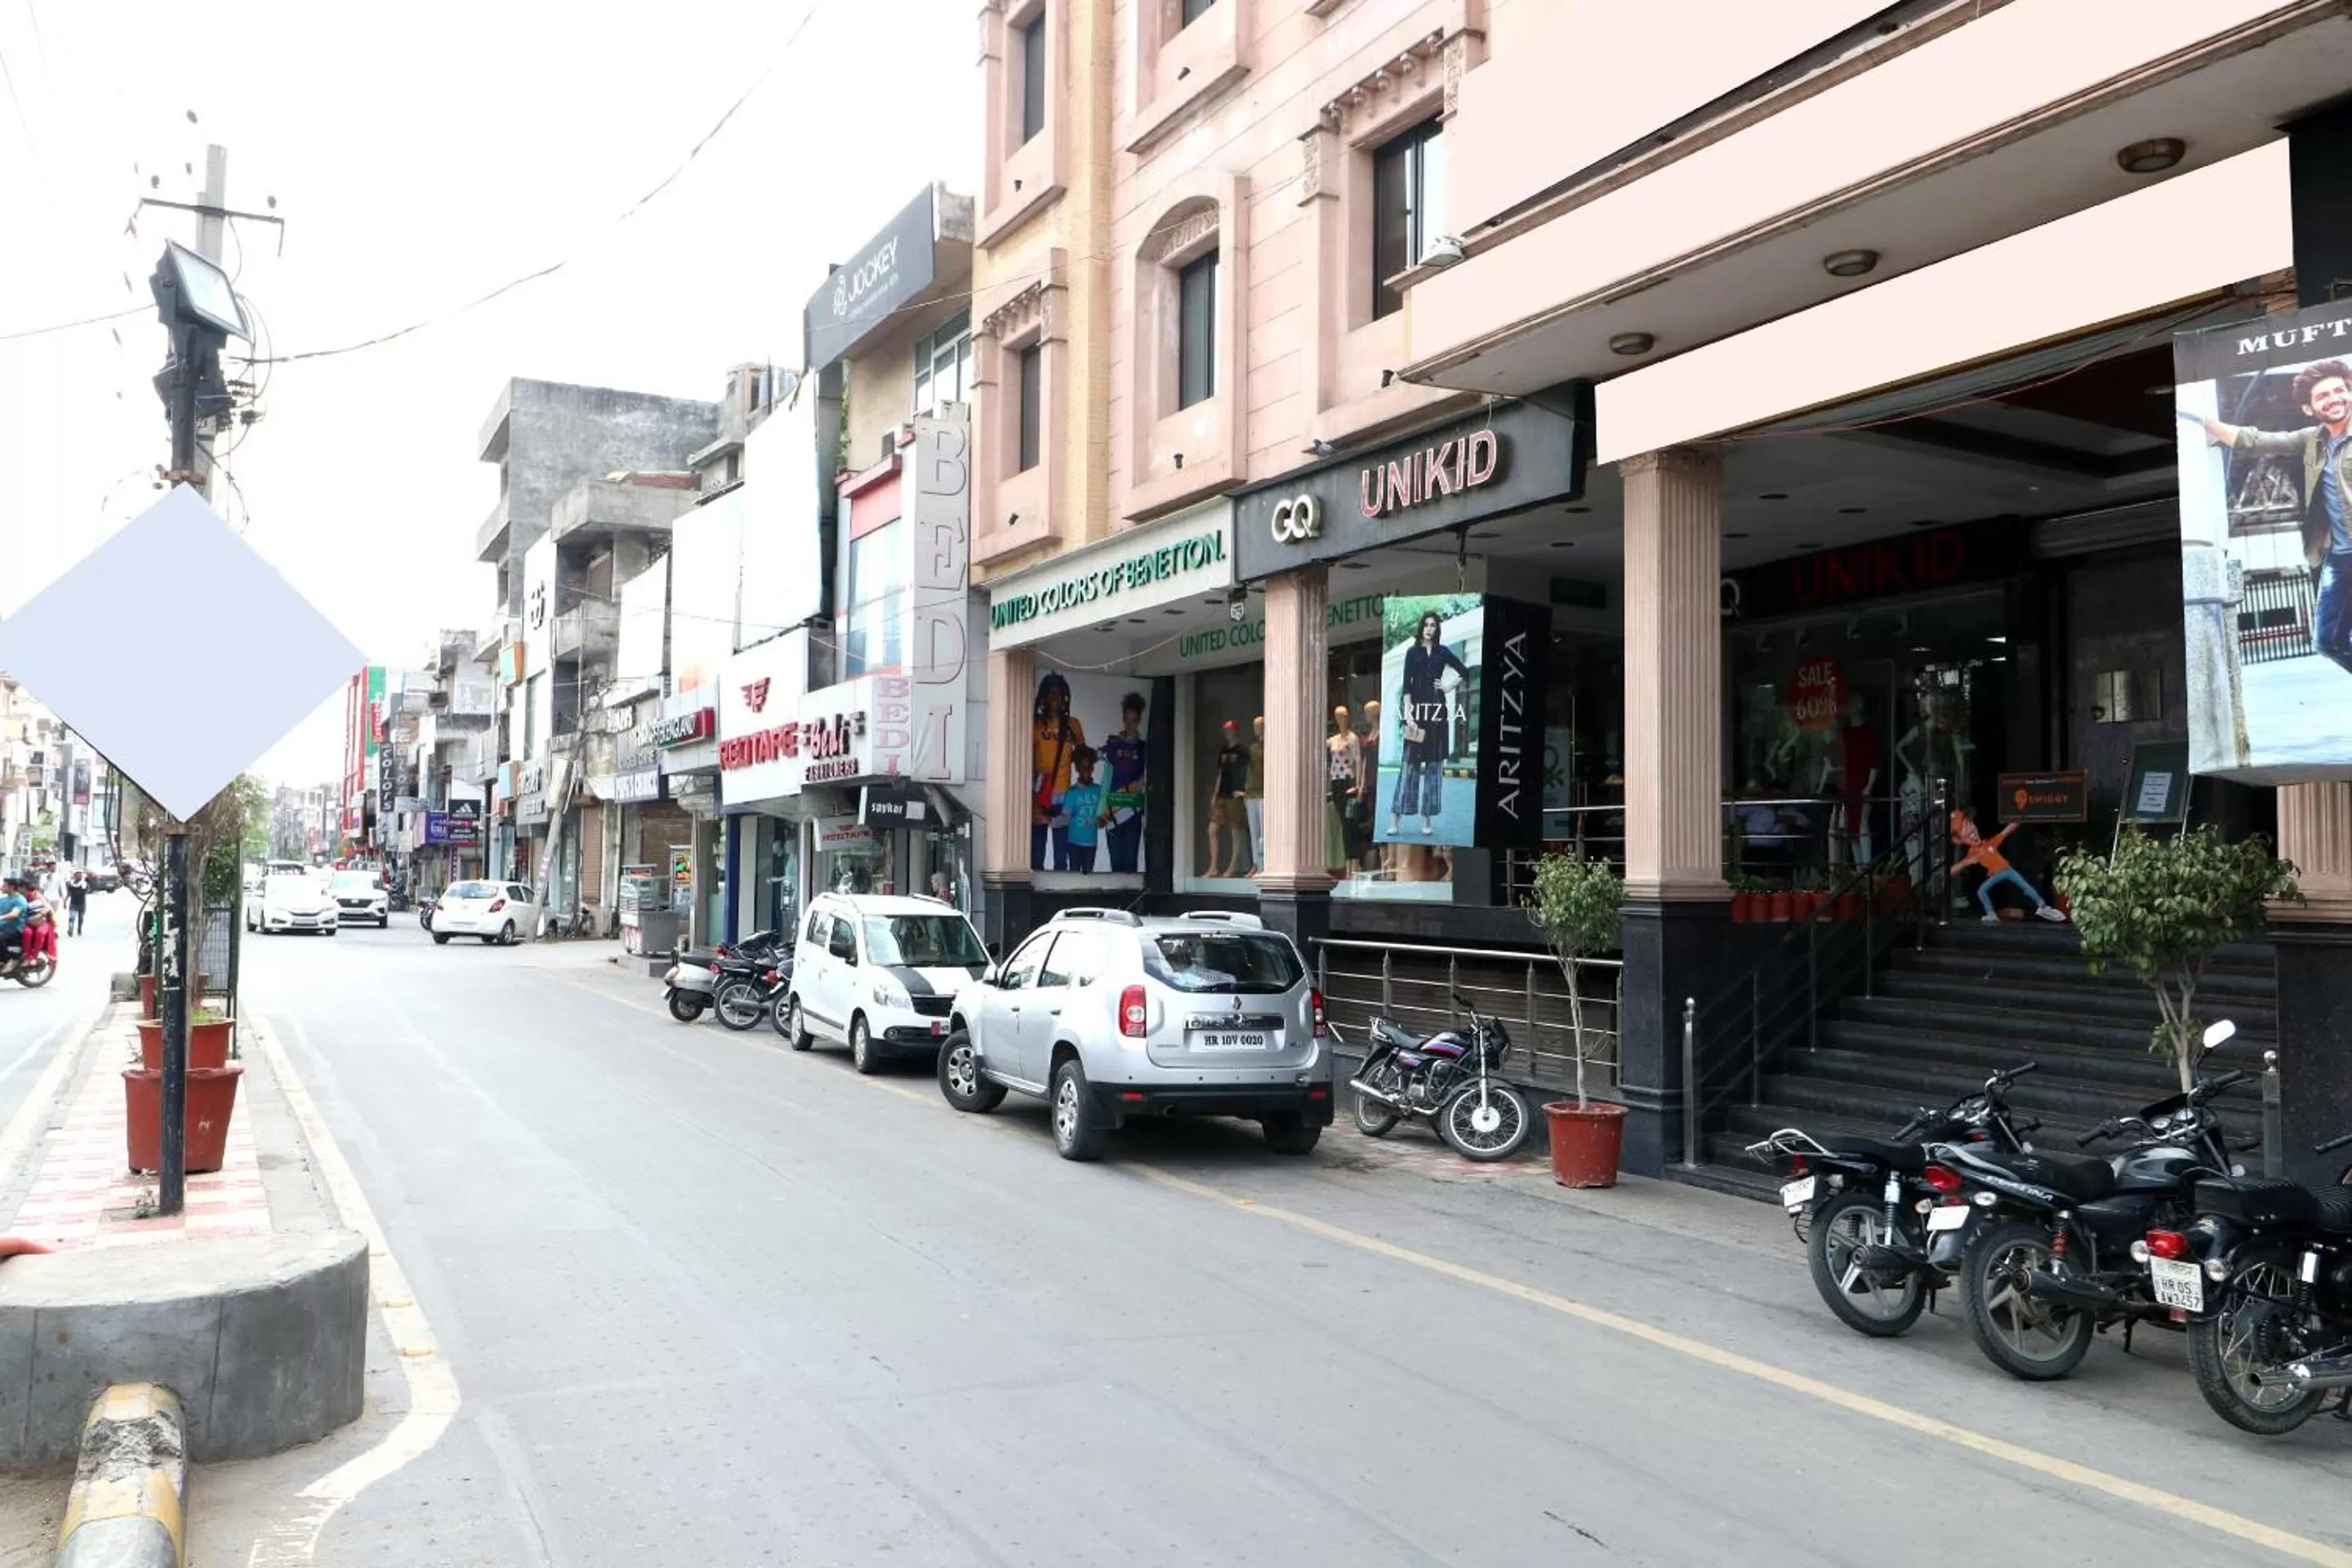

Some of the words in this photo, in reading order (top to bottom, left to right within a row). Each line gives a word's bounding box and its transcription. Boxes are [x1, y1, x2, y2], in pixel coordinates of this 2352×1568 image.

[849, 235, 898, 302] JOCKEY
[2236, 318, 2352, 355] MUFT
[1361, 429, 1497, 518] UNIKID
[1272, 494, 1321, 542] GQ
[990, 594, 1038, 629] UNITED
[1040, 572, 1098, 615] COLORS
[1101, 563, 1125, 596] OF
[1793, 532, 1966, 604] UNIKID
[915, 425, 967, 780] BEDI
[1327, 589, 1399, 628] ENETTO
[1179, 627, 1227, 657] UNITED
[1797, 662, 1833, 688] SALE
[875, 677, 910, 777] BEDI
[1498, 631, 1527, 819] ARITZYA
[1204, 1036, 1218, 1046] HR
